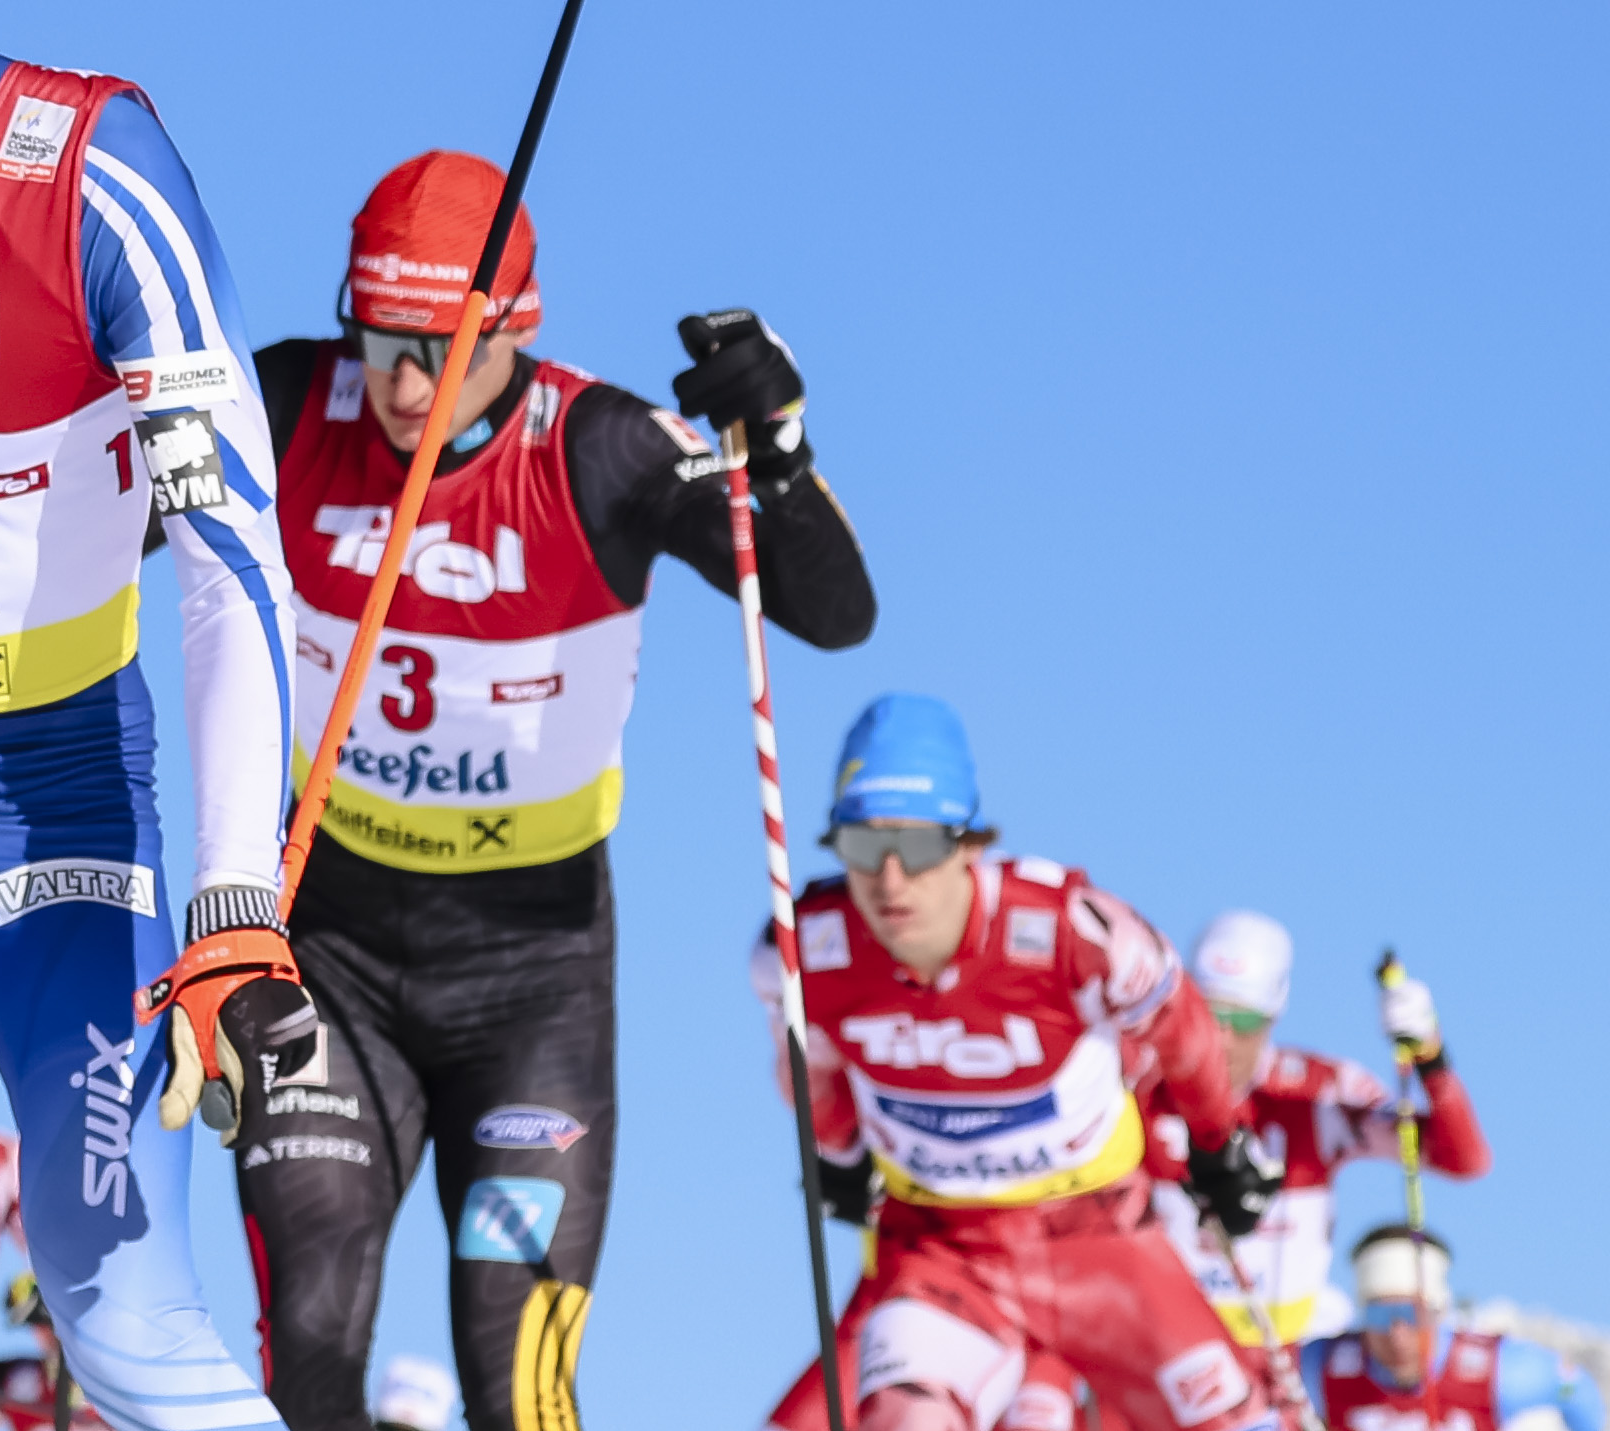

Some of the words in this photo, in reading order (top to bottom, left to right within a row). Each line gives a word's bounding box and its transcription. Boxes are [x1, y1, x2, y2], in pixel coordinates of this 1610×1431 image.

[153, 473, 222, 512] SVM
[379, 644, 437, 732] 3
[841, 1011, 1046, 1080] Tirol
